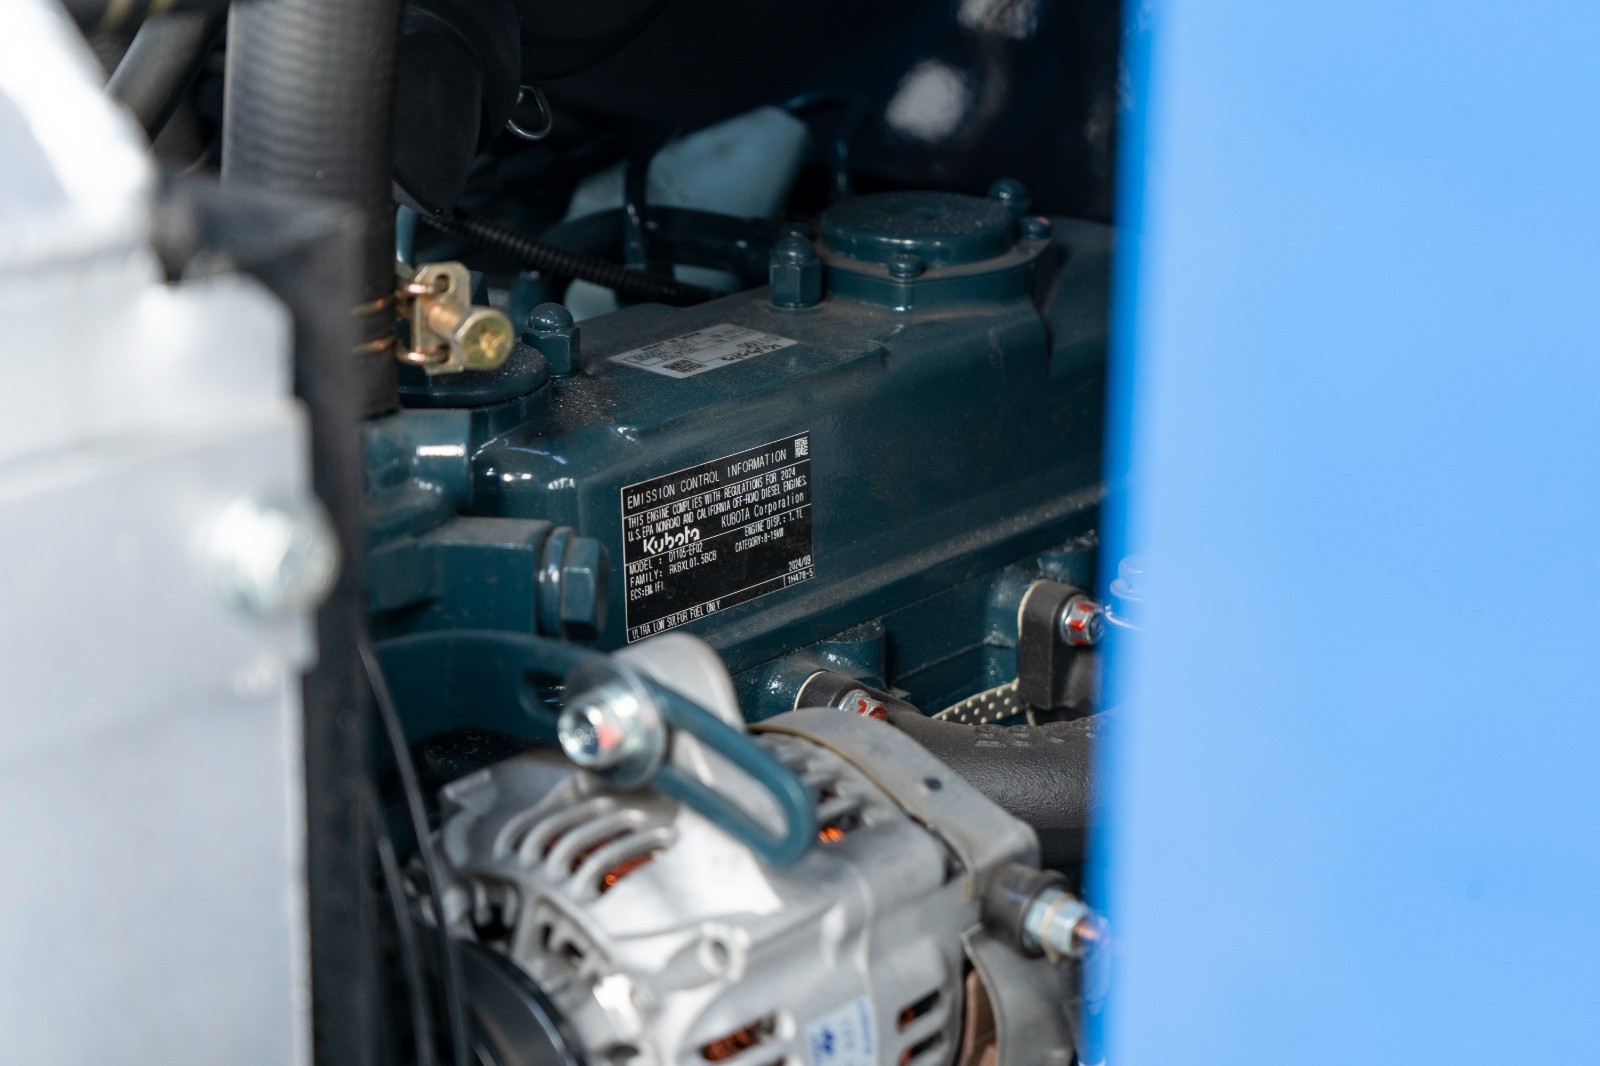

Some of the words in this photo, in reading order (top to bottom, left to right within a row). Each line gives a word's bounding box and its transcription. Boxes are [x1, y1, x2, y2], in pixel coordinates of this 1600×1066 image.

[627, 484, 675, 509] EMISSION
[680, 471, 719, 493] CONTROL
[727, 449, 786, 478] INFORMATION
[627, 515, 643, 529] THIS
[646, 506, 669, 523] ENGINE
[672, 496, 702, 515] COMPLIES
[704, 490, 720, 505] WITH
[723, 478, 762, 498] REGULATIONS
[765, 473, 776, 485] FOR
[780, 467, 796, 480] 2024
[655, 516, 680, 533] NONROAD
[682, 511, 693, 525] AND
[696, 501, 730, 520] CALIFORNIA
[732, 490, 759, 509] OFF-ROAD
[761, 484, 780, 499] DIESEL
[721, 508, 750, 528] KUBOTA
[754, 492, 804, 518] Corporation
[643, 525, 700, 555] Kubota
[744, 521, 766, 537] ENGINE
[629, 559, 652, 575] MODEL
[629, 569, 662, 588] FAMILY:
[788, 555, 811, 571] 2024/09
[631, 624, 650, 640] ULTRA
[653, 619, 664, 632] LOW
[666, 611, 687, 627] SULFUR
[690, 606, 704, 619] FUEL
[706, 600, 720, 613] ONLY
